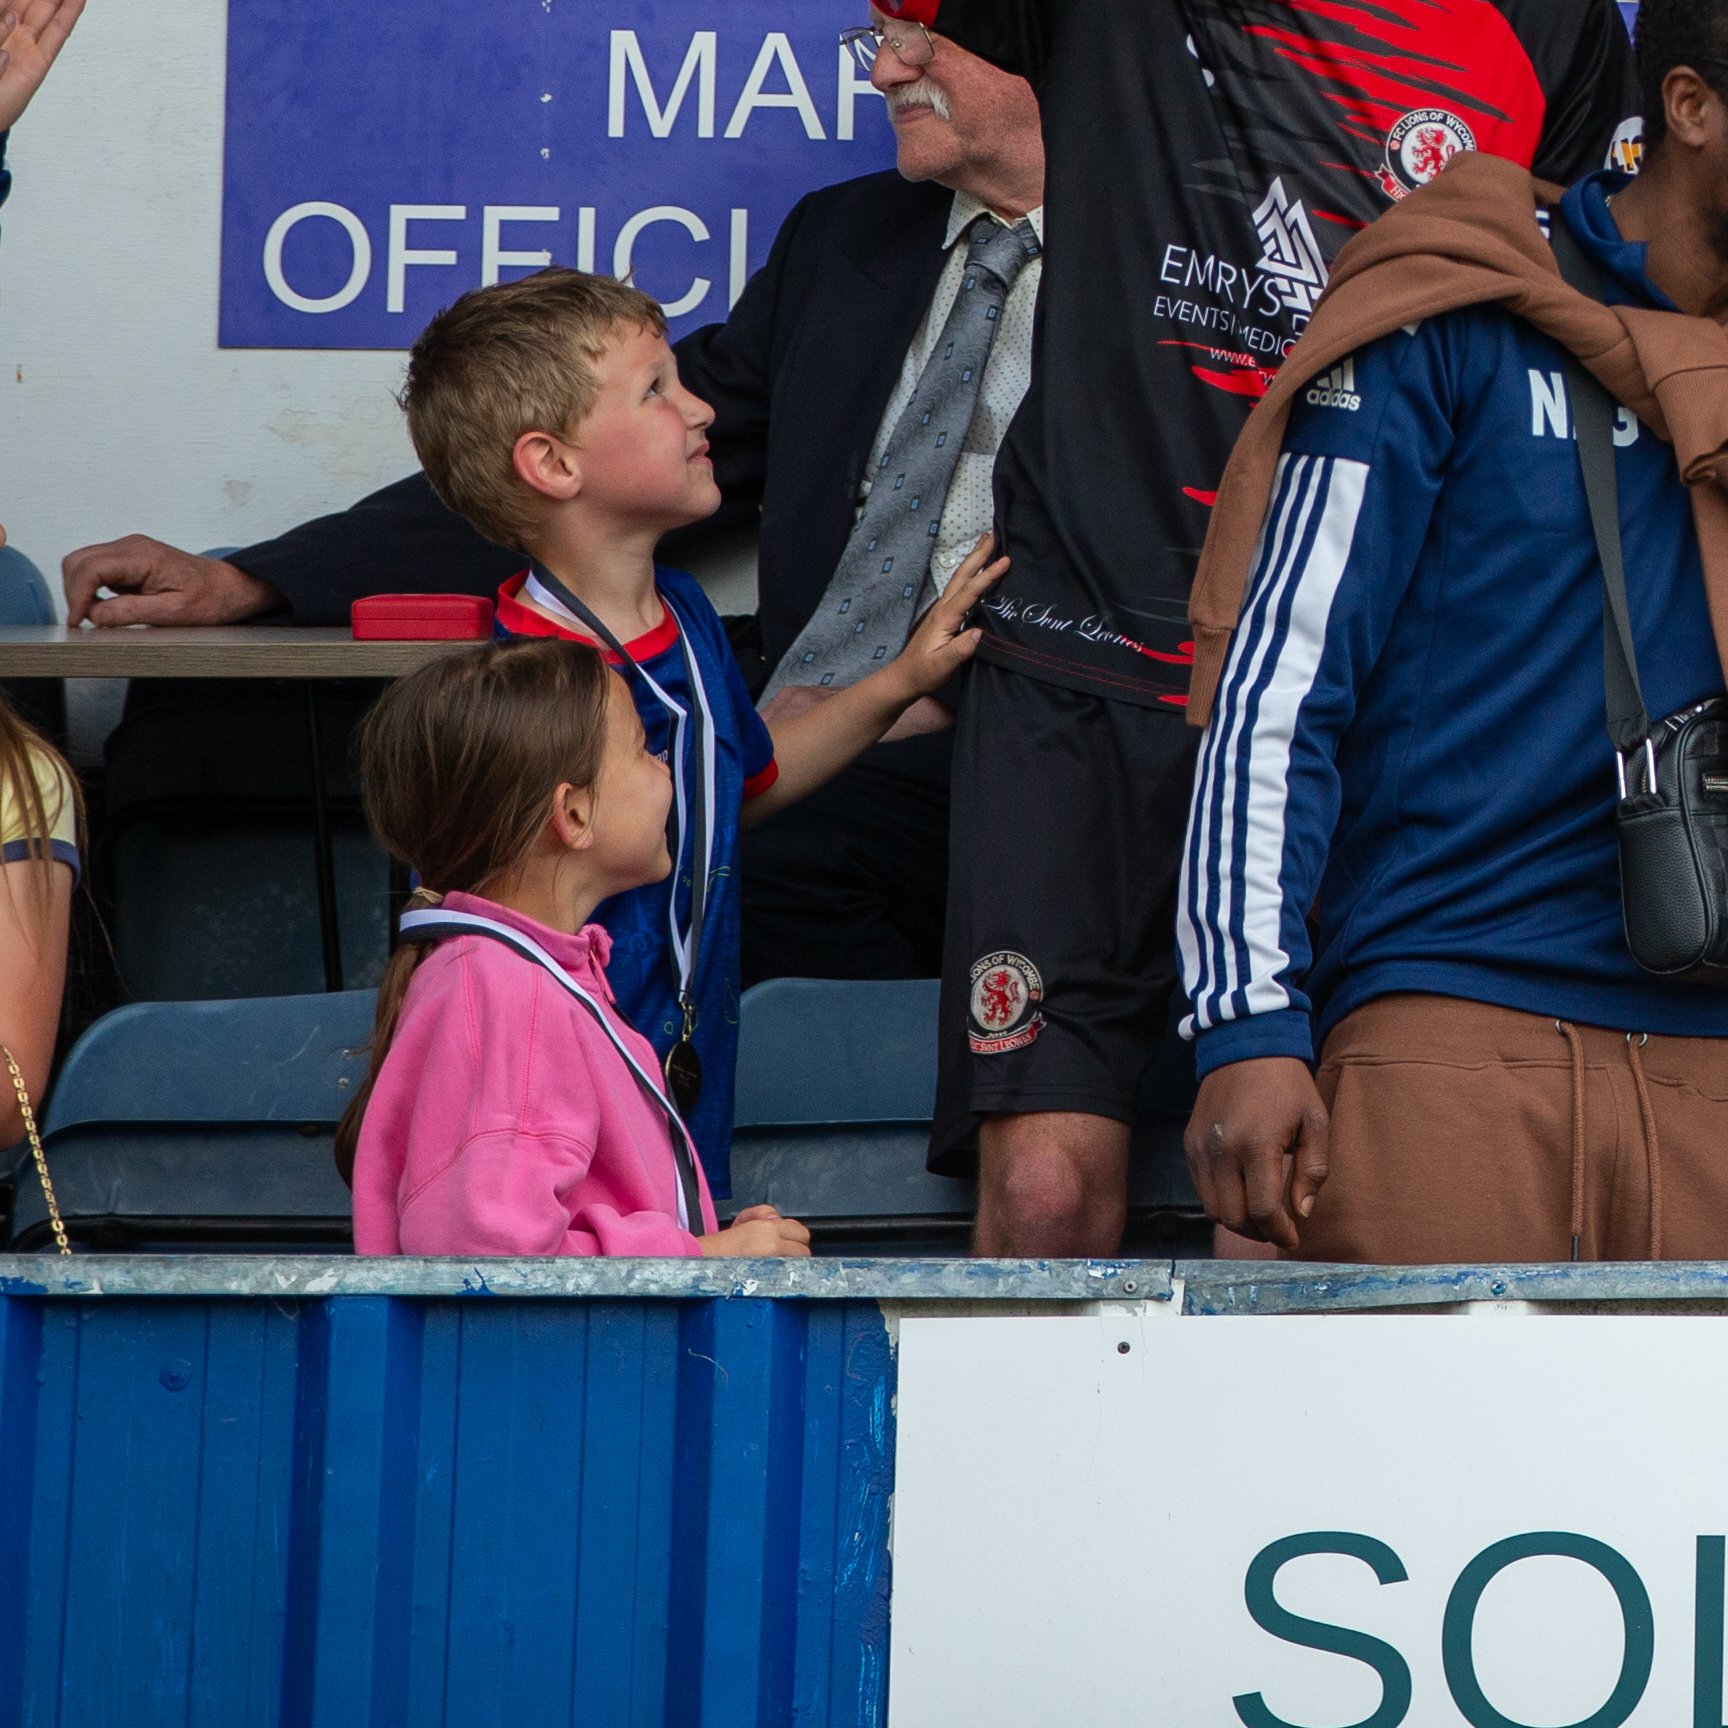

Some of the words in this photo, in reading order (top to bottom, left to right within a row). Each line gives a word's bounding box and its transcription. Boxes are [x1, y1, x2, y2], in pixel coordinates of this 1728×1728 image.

[1393, 126, 1406, 141] FC
[1401, 111, 1429, 130] LIONS
[1429, 112, 1444, 121] OF
[1160, 244, 1280, 317] EMRYS
[1306, 388, 1362, 412] adidas
